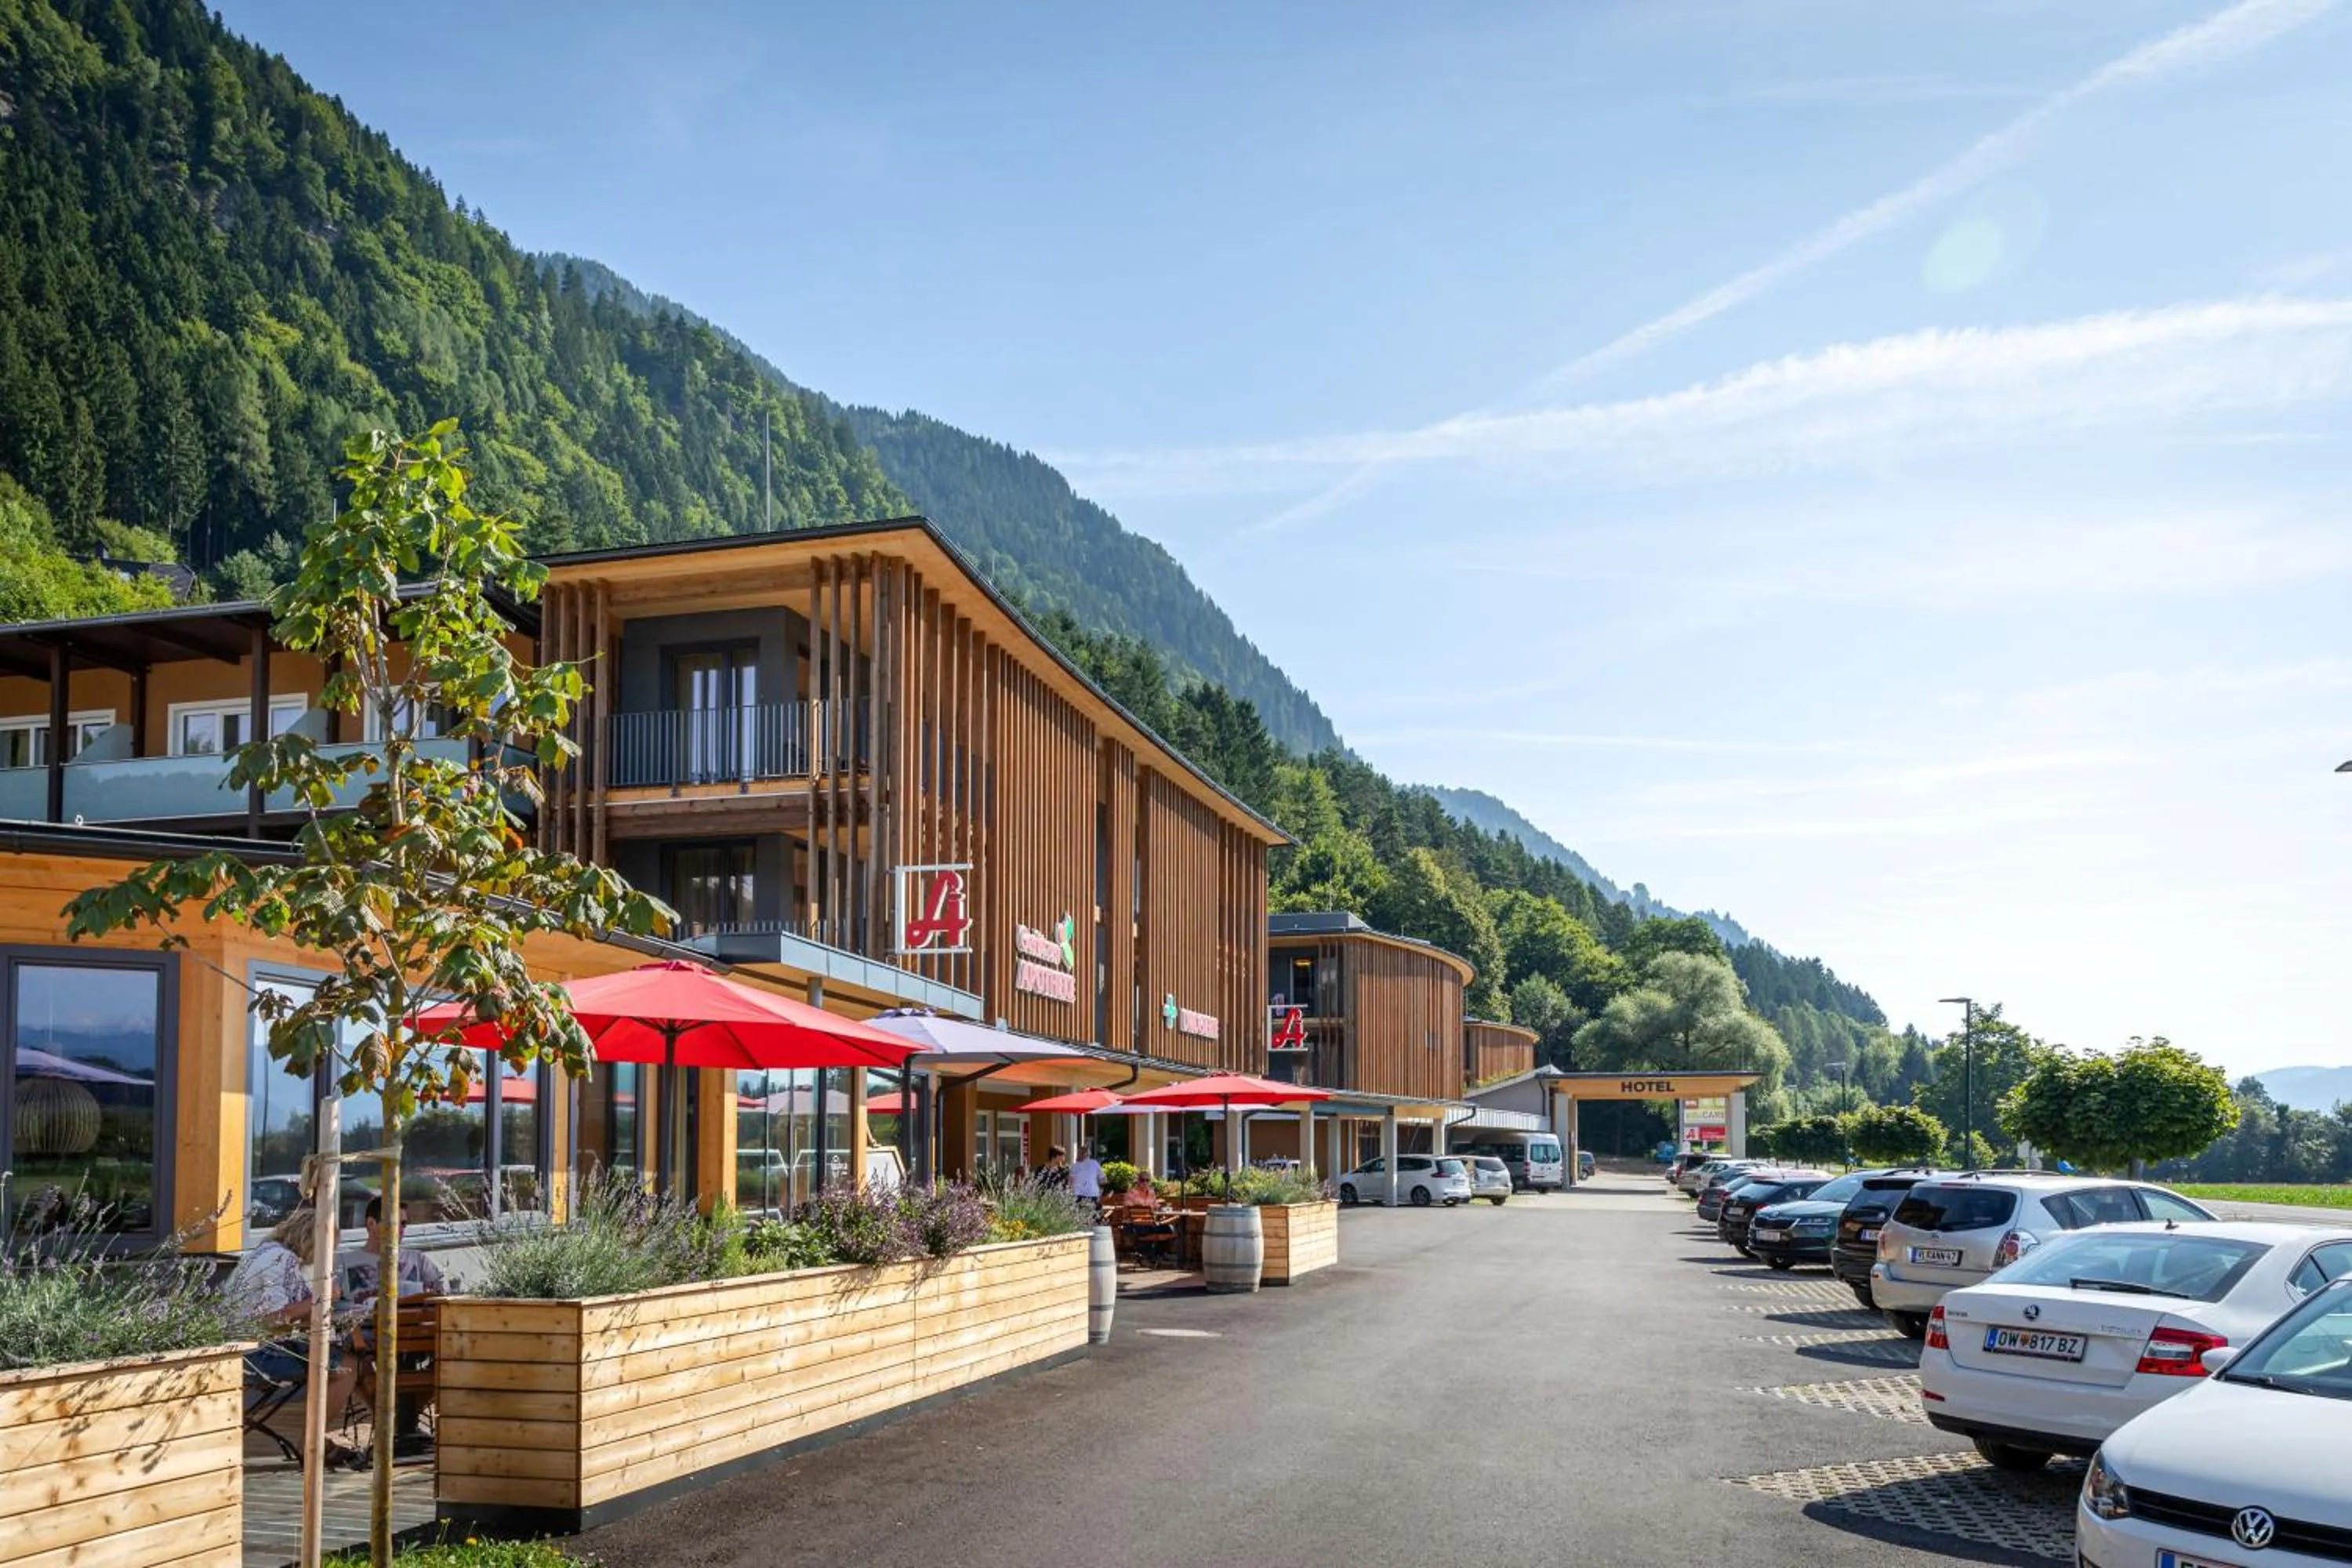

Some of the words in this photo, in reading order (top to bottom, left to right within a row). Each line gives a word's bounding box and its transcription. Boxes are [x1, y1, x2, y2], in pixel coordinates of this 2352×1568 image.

[1621, 1081, 1675, 1092] HOTEL
[1998, 1331, 2019, 1347] OW
[2029, 1334, 2056, 1351] 817
[2057, 1338, 2078, 1354] BZ
